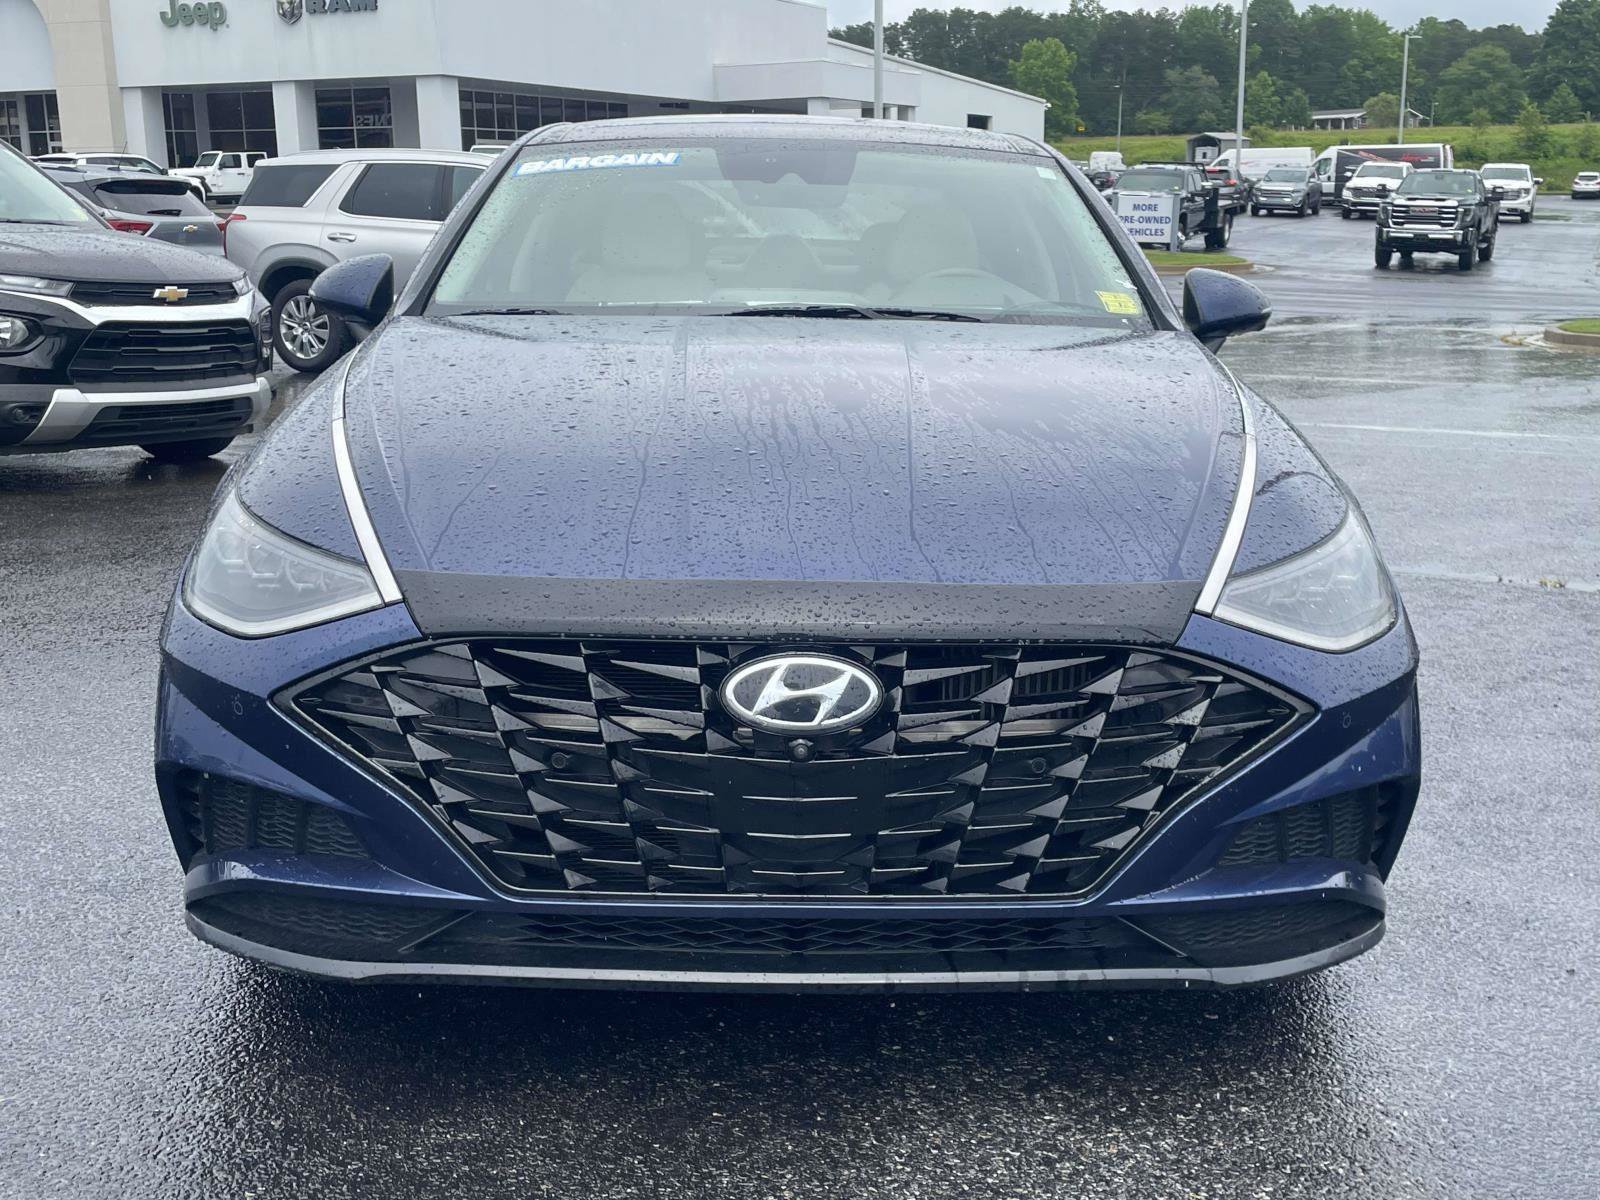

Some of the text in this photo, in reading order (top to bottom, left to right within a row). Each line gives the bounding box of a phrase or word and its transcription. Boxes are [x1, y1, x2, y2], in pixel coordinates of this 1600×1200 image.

[159, 0, 227, 31] Jeep
[516, 152, 680, 175] BARGAIN
[1133, 203, 1159, 212] MORE
